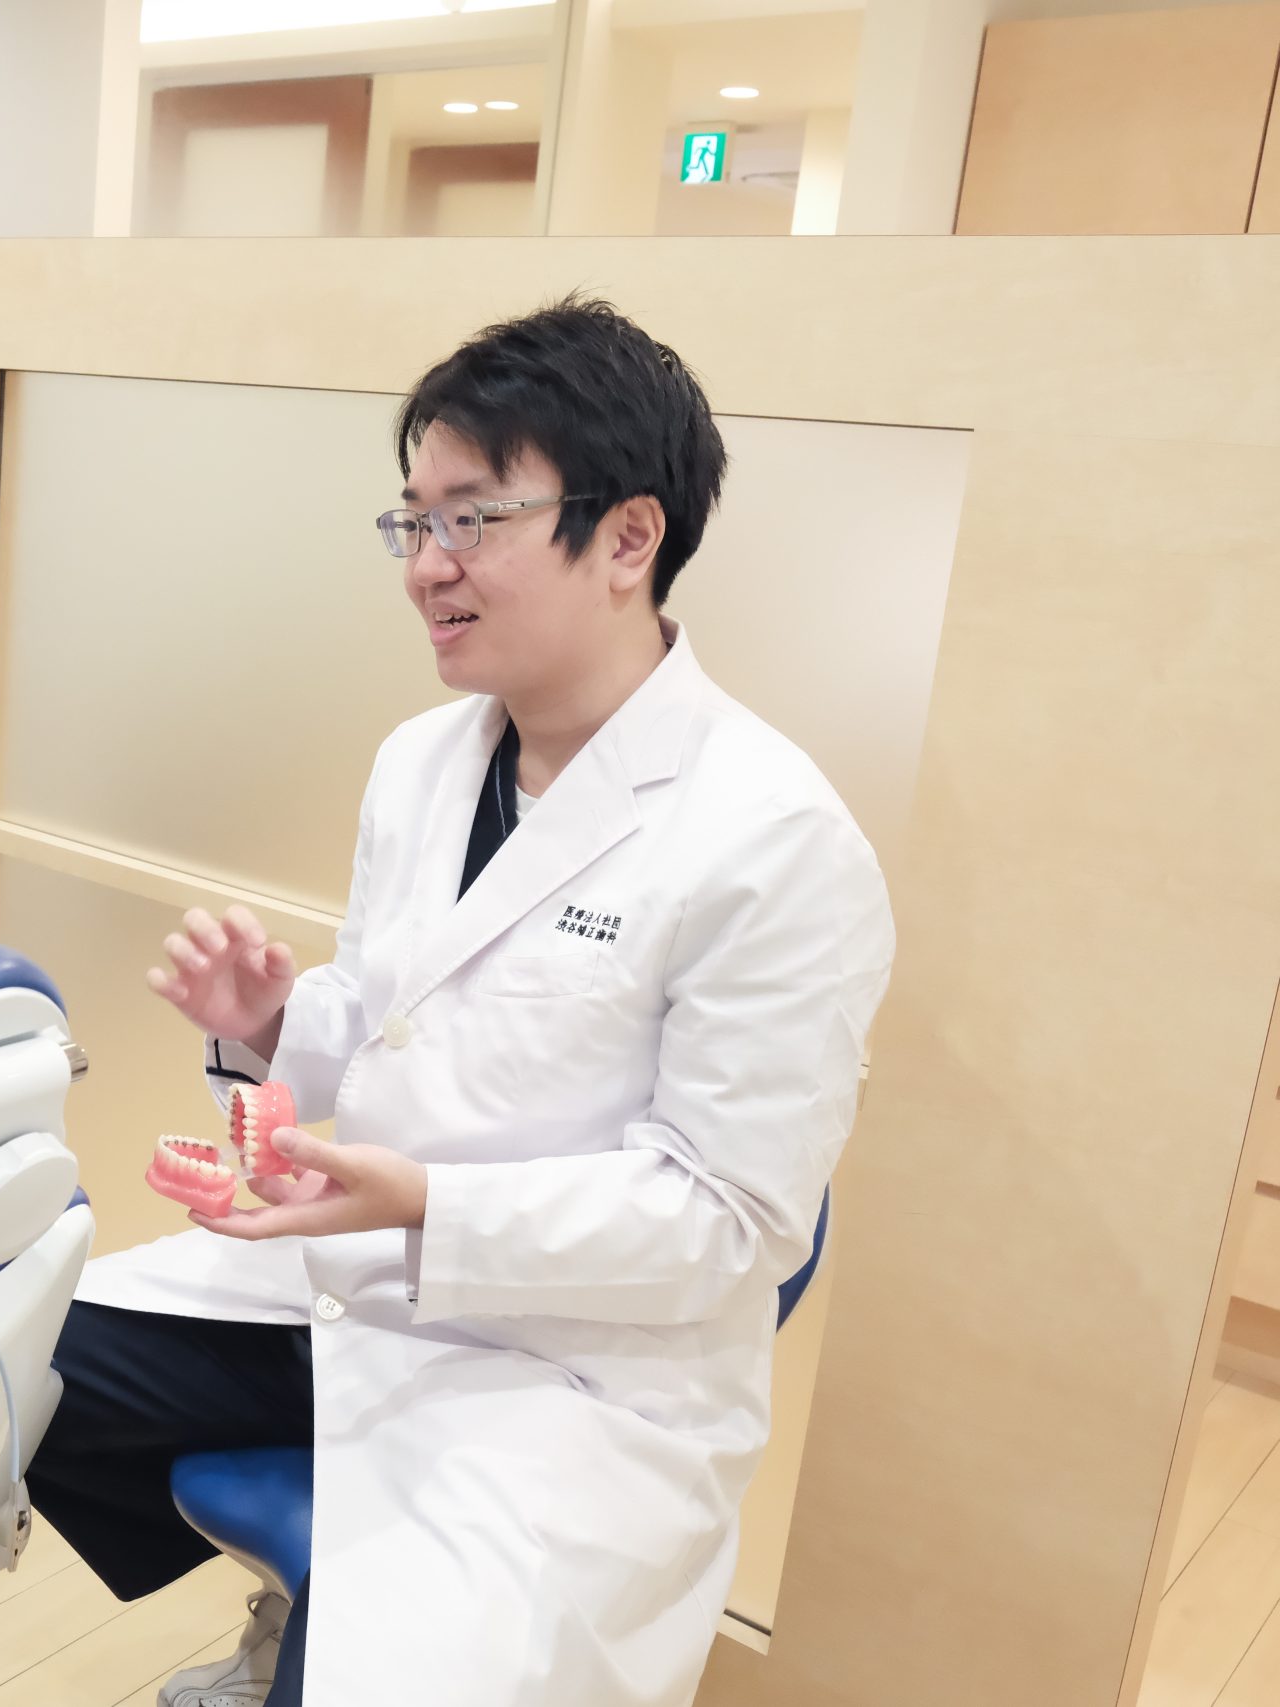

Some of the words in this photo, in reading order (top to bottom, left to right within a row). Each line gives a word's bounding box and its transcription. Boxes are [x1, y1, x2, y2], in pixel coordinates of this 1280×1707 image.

[563, 905, 622, 930] 医療法人社団
[555, 918, 617, 945] 渋谷矯正歯科
